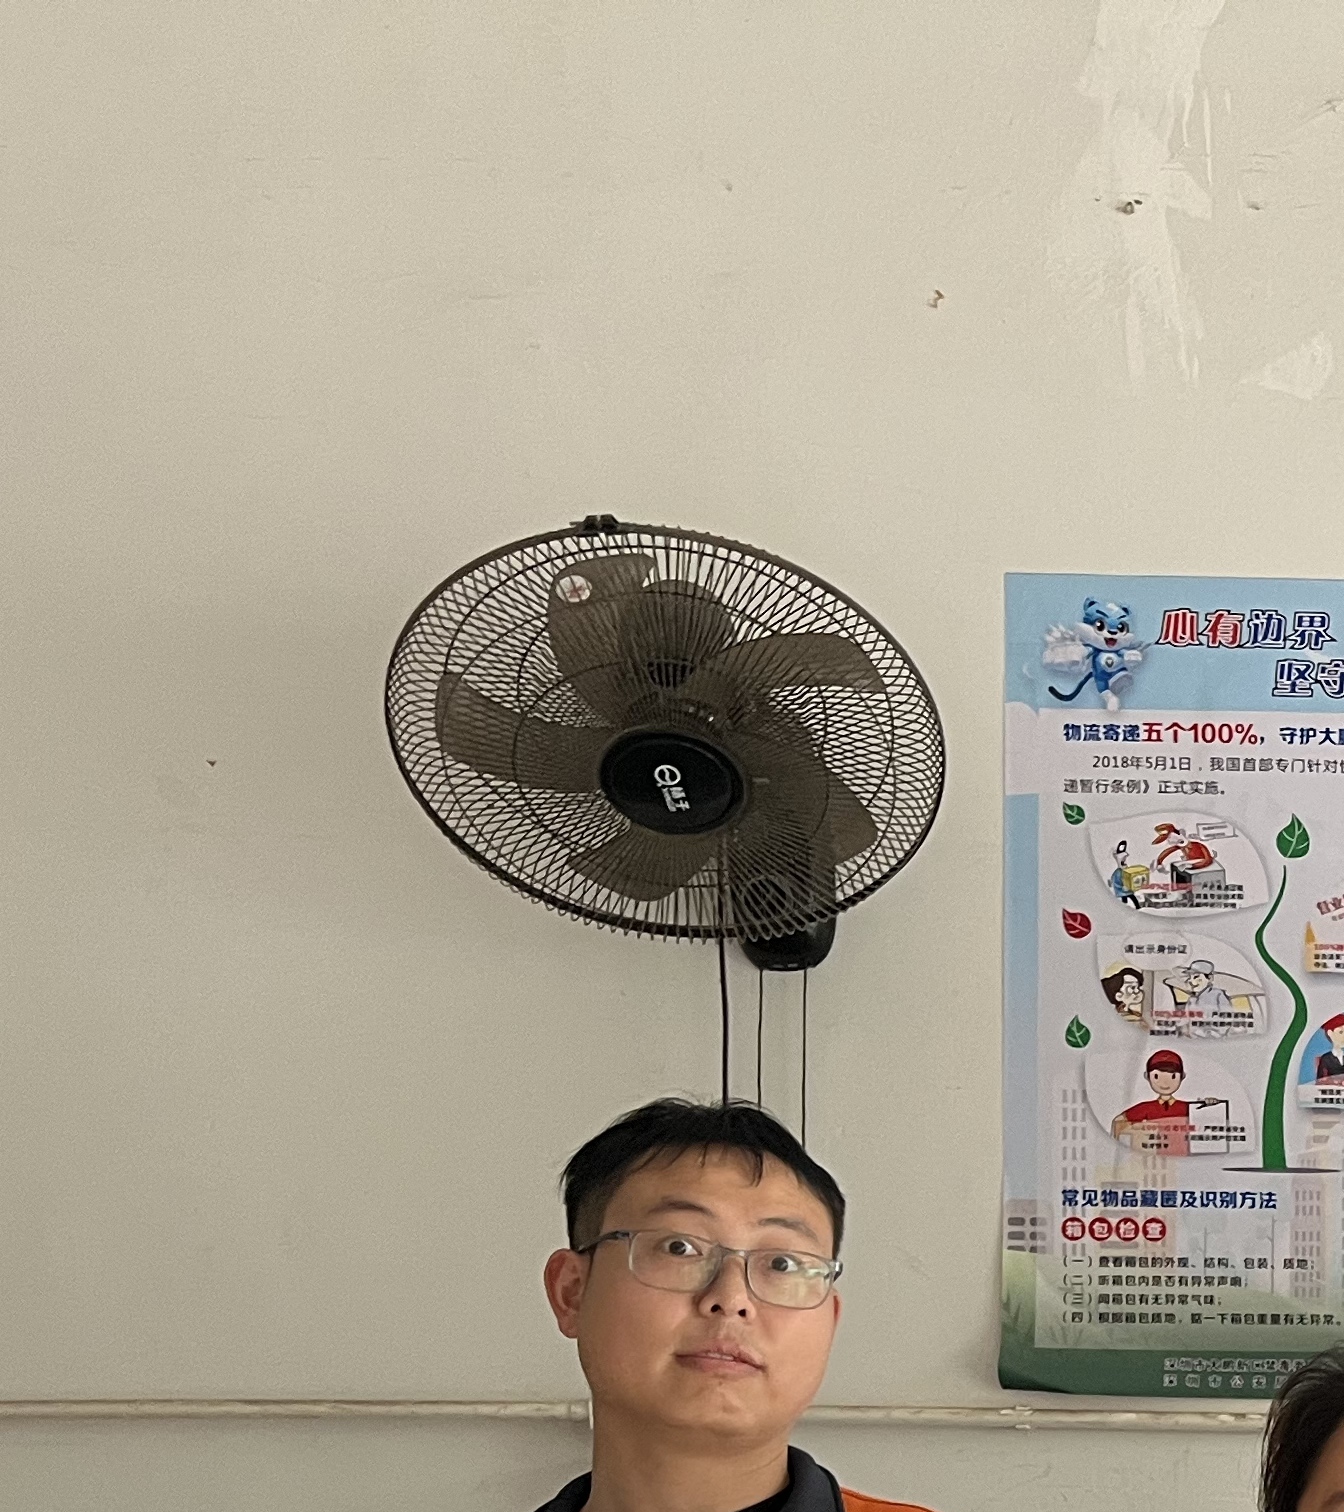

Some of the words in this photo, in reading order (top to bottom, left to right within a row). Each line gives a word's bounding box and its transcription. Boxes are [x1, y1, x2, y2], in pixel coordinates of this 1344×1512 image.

[1156, 608, 1337, 650] 心有边界
[1062, 1189, 1278, 1210] 常见物品藏匿及识别方法
[1064, 1219, 1165, 1241] 箱包检查
